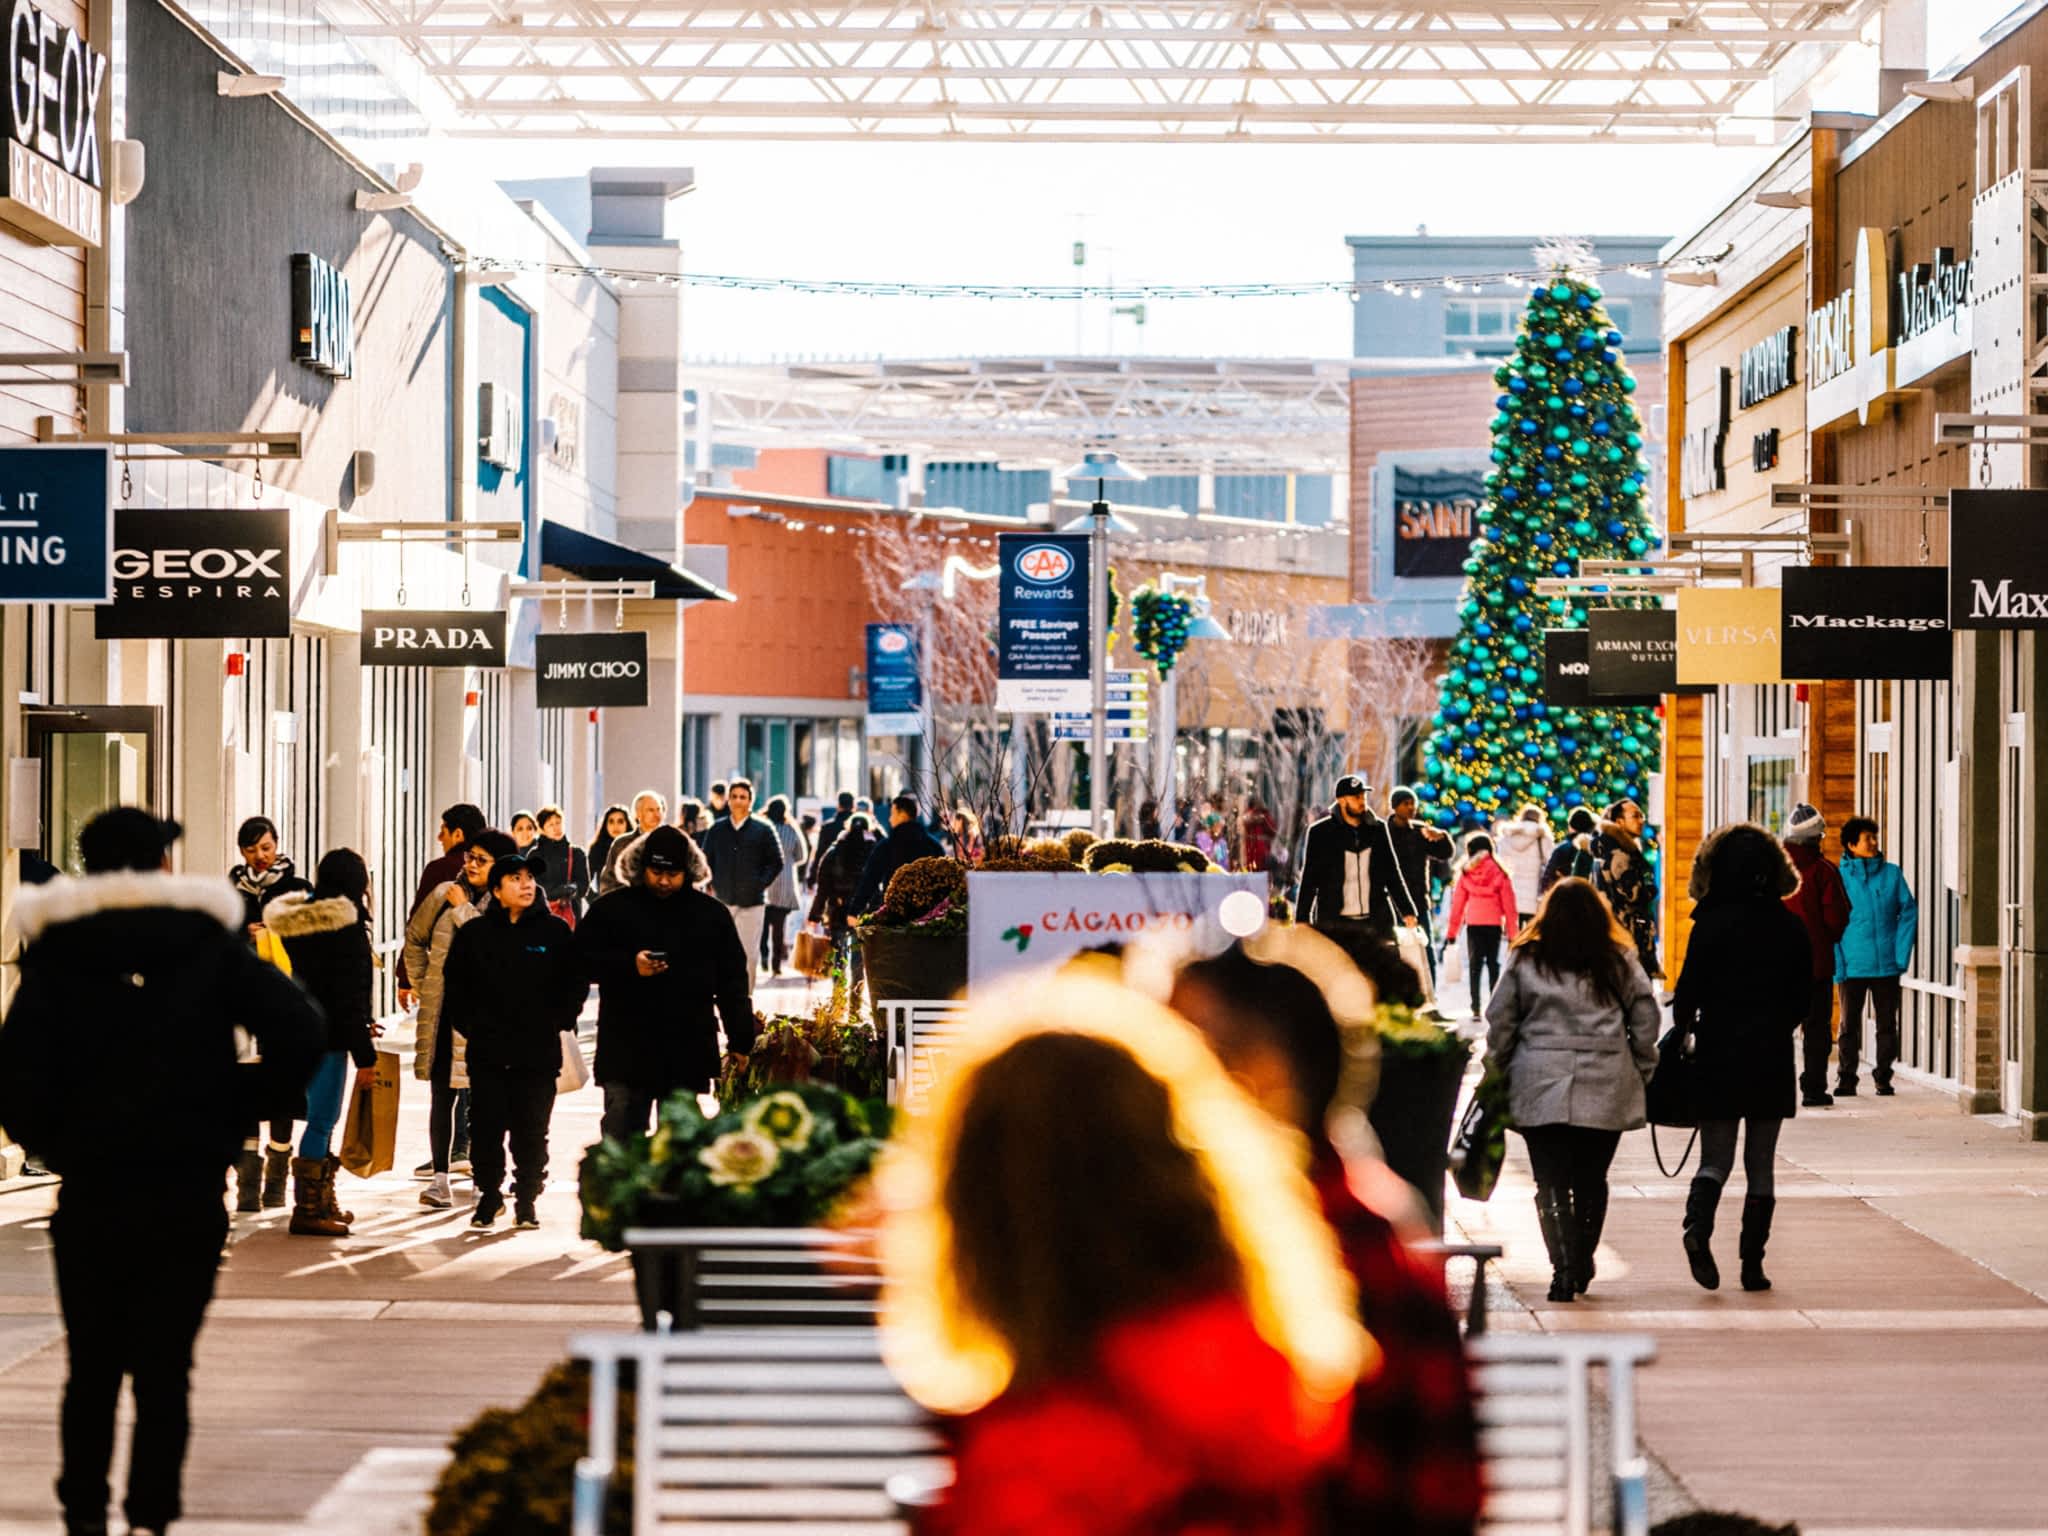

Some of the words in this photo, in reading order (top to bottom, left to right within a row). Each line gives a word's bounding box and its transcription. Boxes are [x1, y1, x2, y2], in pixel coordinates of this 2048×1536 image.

[10, 0, 106, 188] GEOX
[14, 145, 98, 241] RESPIRA
[19, 493, 39, 510] IT
[1399, 500, 1477, 539] SAINT
[2, 536, 66, 565] ING
[113, 549, 282, 579] GEOX
[1023, 551, 1066, 576] CAA
[1014, 586, 1074, 599] Rewards
[1969, 579, 2048, 618] Max
[1010, 619, 1037, 629] FREE
[1040, 619, 1079, 631] Savings
[1788, 614, 1946, 631] Mackage
[374, 627, 493, 649] PRADA
[1022, 631, 1067, 641] Passport
[1596, 641, 1641, 651] ARMANI
[1685, 626, 1777, 646] VERSA
[1631, 653, 1675, 662] OUTLET
[544, 664, 586, 679] JIMMY
[590, 662, 640, 678] CHOO
